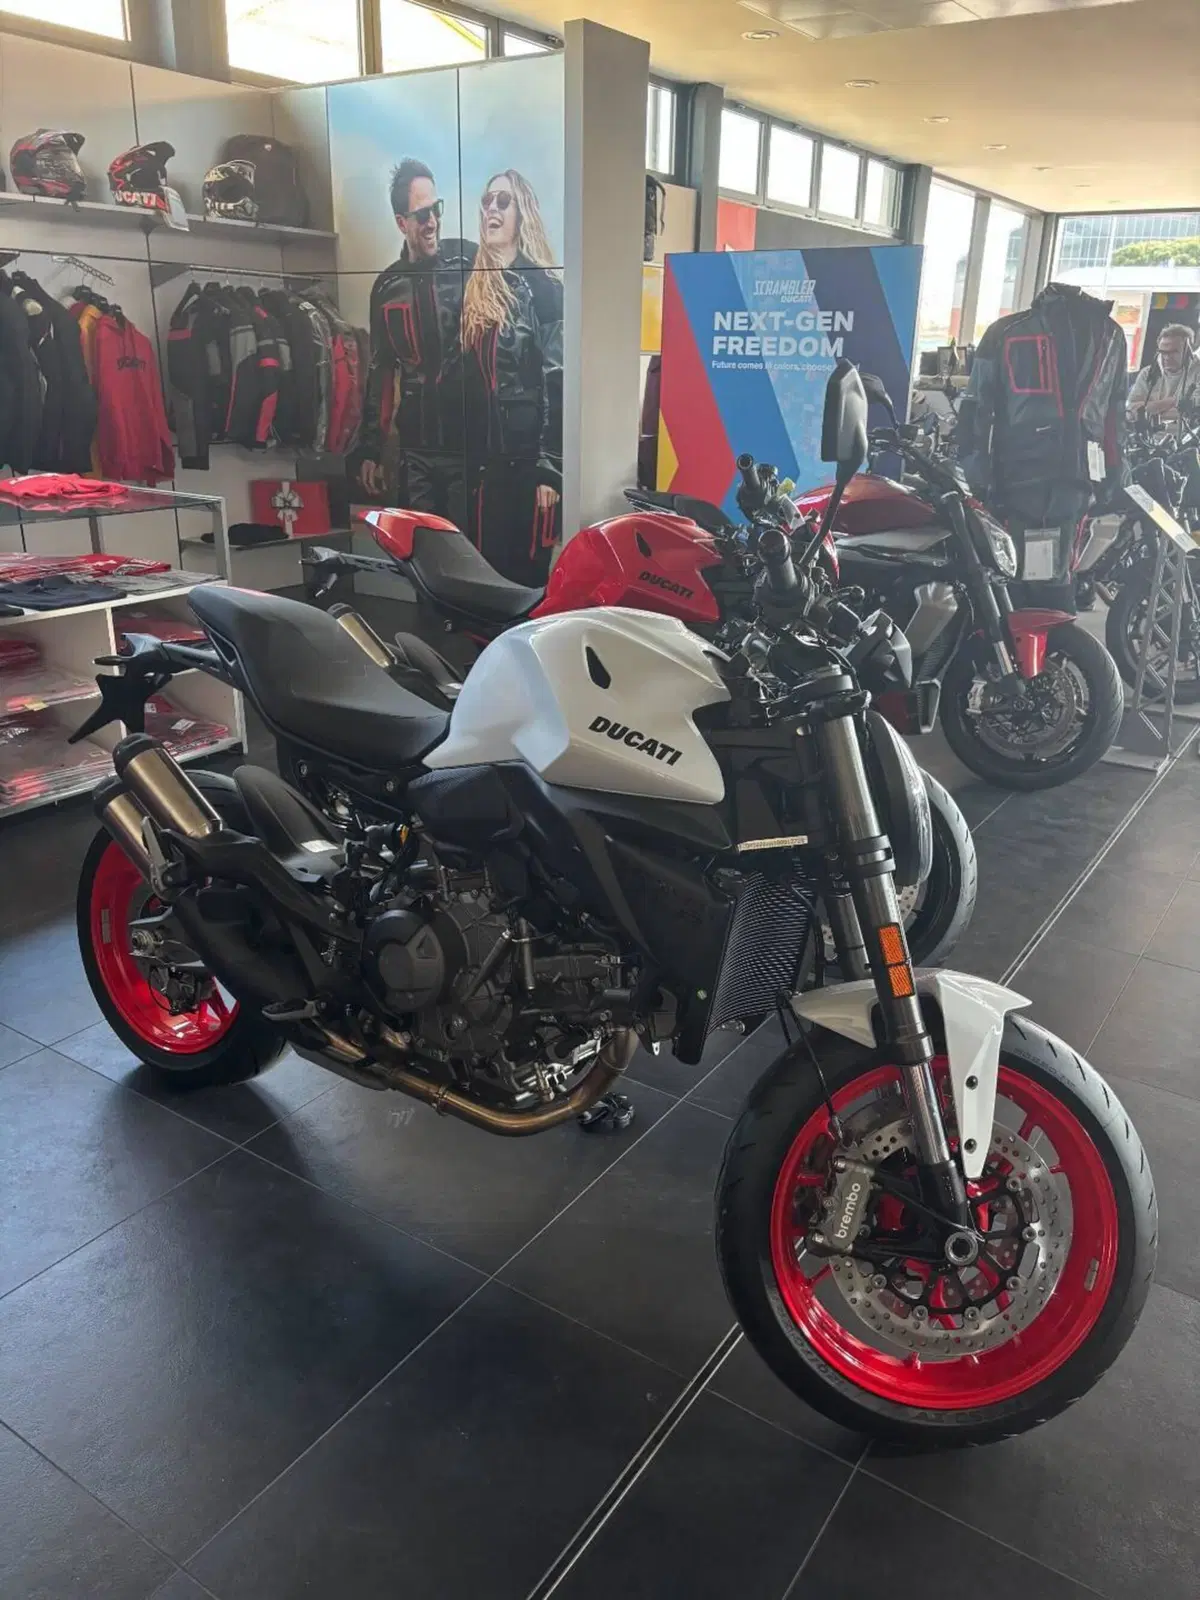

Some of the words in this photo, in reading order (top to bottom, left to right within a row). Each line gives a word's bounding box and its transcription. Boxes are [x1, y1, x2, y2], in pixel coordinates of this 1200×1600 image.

[753, 279, 816, 296] SCRAMBLER
[713, 311, 854, 332] NEXT-GEN
[712, 336, 843, 357] FREEDOM
[711, 360, 736, 369] Future
[737, 361, 763, 370] comes
[638, 571, 695, 599] DUCATI
[588, 716, 683, 766] DUCATI
[834, 1182, 861, 1239] brembo
